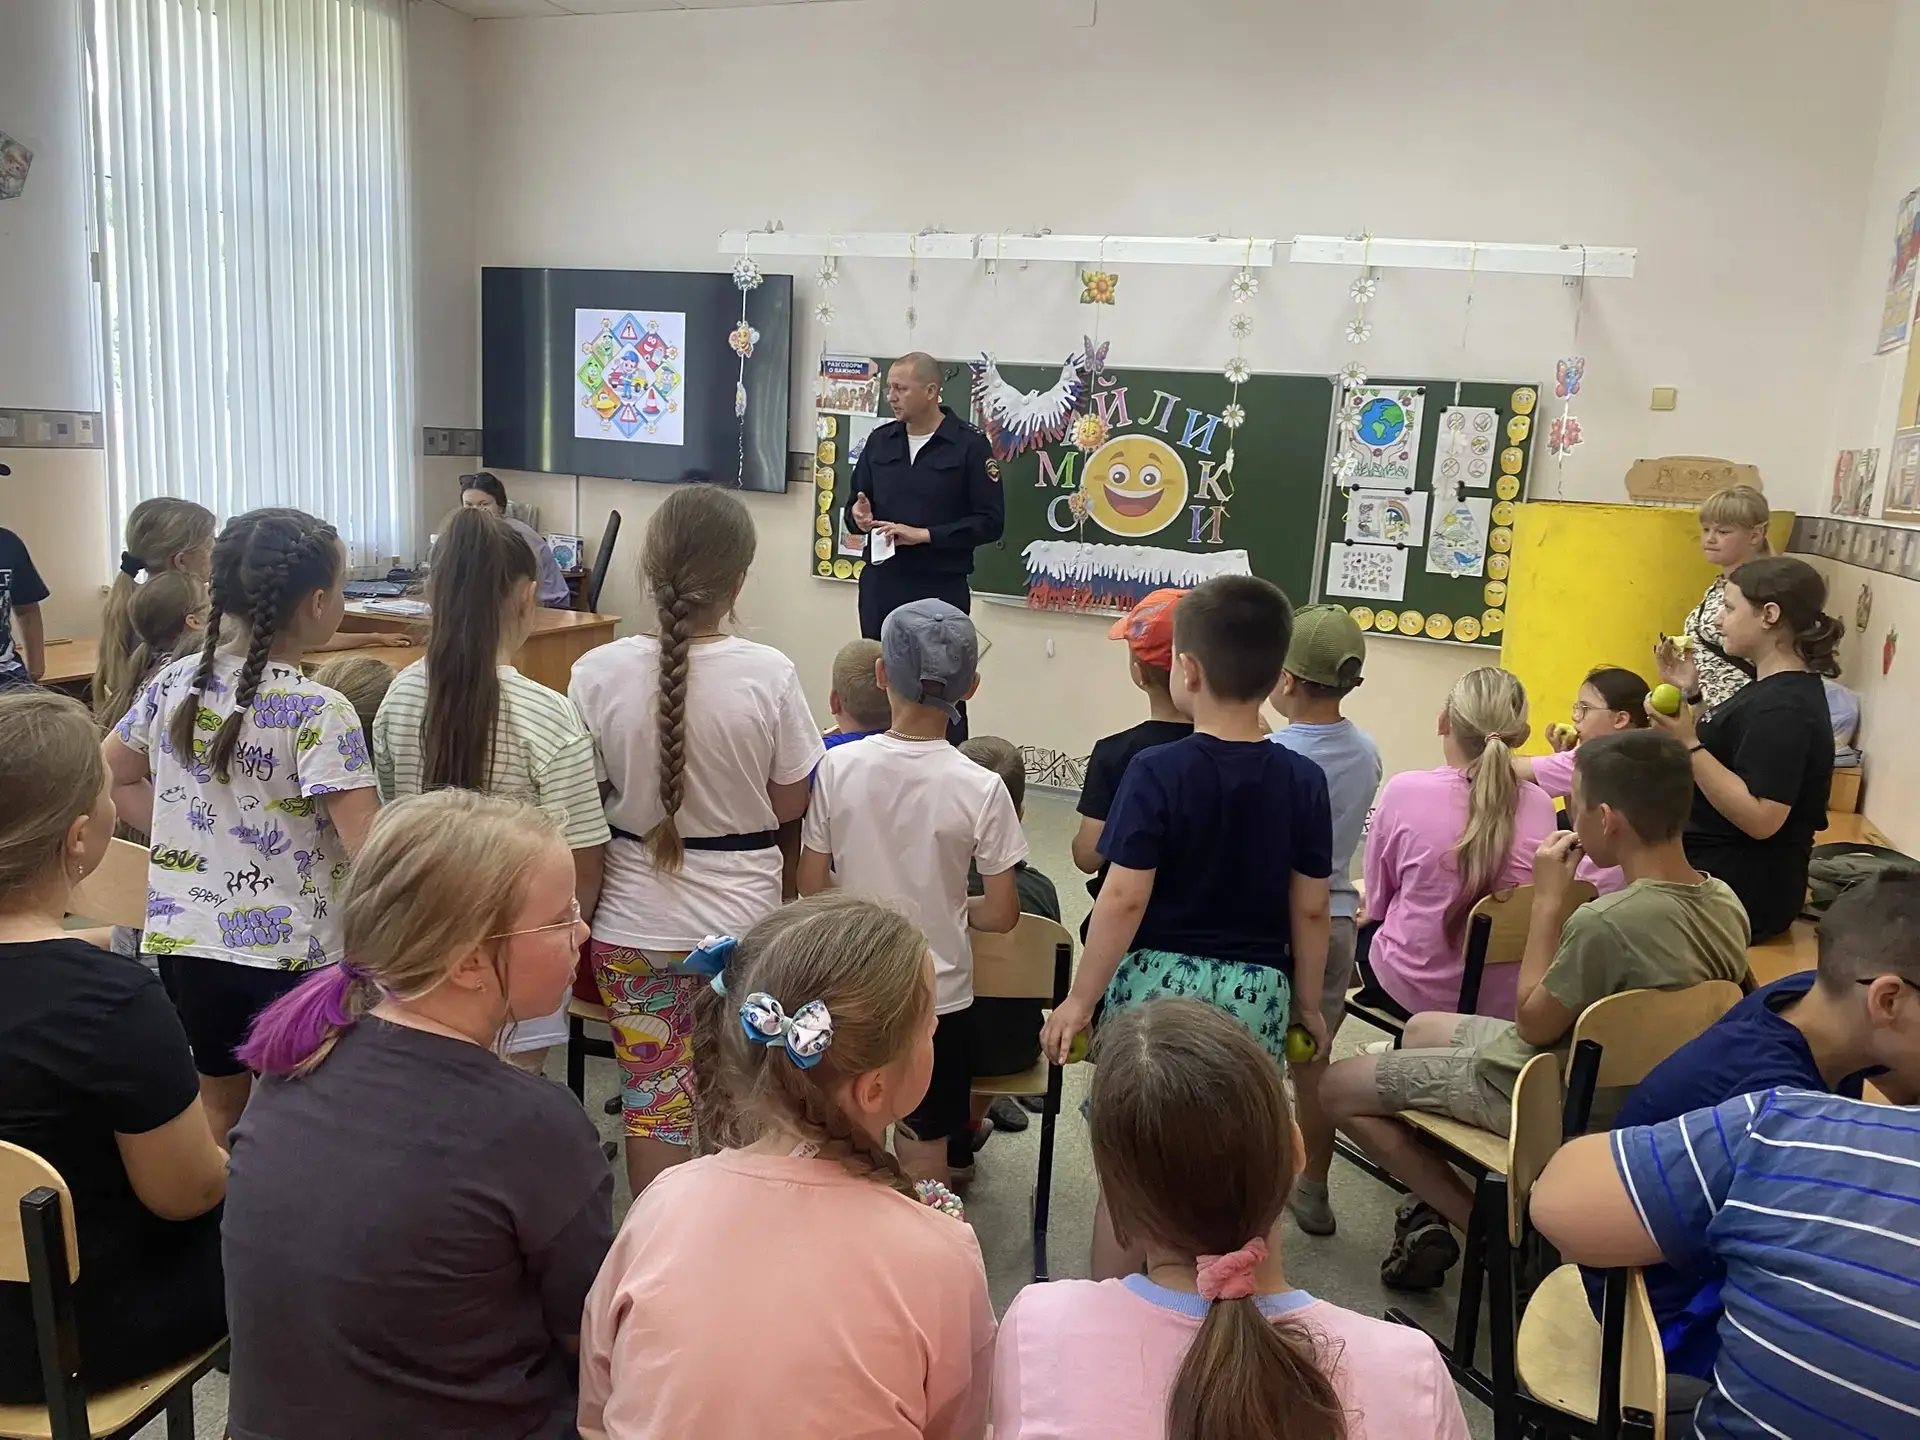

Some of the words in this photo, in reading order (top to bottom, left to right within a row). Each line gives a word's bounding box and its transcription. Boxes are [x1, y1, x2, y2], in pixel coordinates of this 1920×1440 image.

[188, 886, 228, 908] SPRAY
[217, 905, 292, 932] WHAT
[222, 922, 293, 948] NOW?
